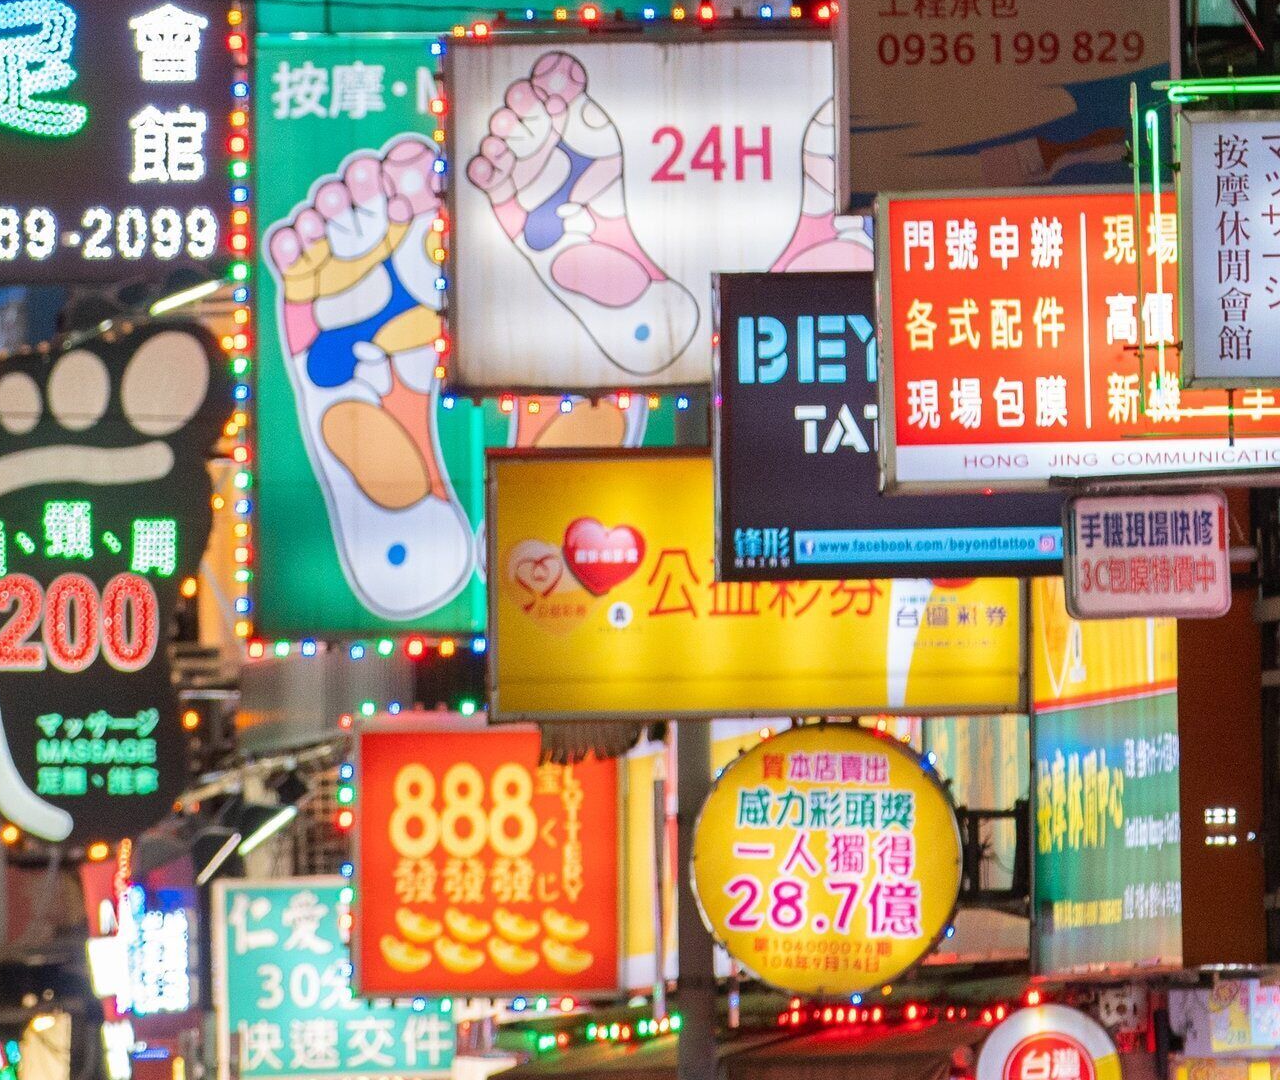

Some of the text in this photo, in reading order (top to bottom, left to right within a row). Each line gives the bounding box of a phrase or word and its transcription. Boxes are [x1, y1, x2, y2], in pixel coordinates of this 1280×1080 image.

[877, 29, 1146, 67] 0936 199 829
[650, 125, 772, 183] 24H
[903, 216, 1064, 272] 門號申辦
[1213, 133, 1253, 362] 按摩休閒會館
[905, 296, 1066, 351] 各式配件
[906, 374, 1068, 430] 現場包膜
[963, 453, 1030, 470] HONG
[1048, 451, 1099, 468] JING
[818, 534, 1036, 555] www.facebook.com/beyondtattoo
[1081, 509, 1214, 548] 手機現場快修
[1081, 553, 1216, 595] 3C包膜特價中
[388, 762, 538, 858] 888
[738, 790, 914, 829] 威力彩頭獎
[392, 856, 534, 904] 發發發
[737, 833, 914, 876] 一人獨得
[228, 890, 351, 955] 仁愛
[726, 878, 921, 936] 28.7億
[238, 1014, 453, 1070] 快速交件
